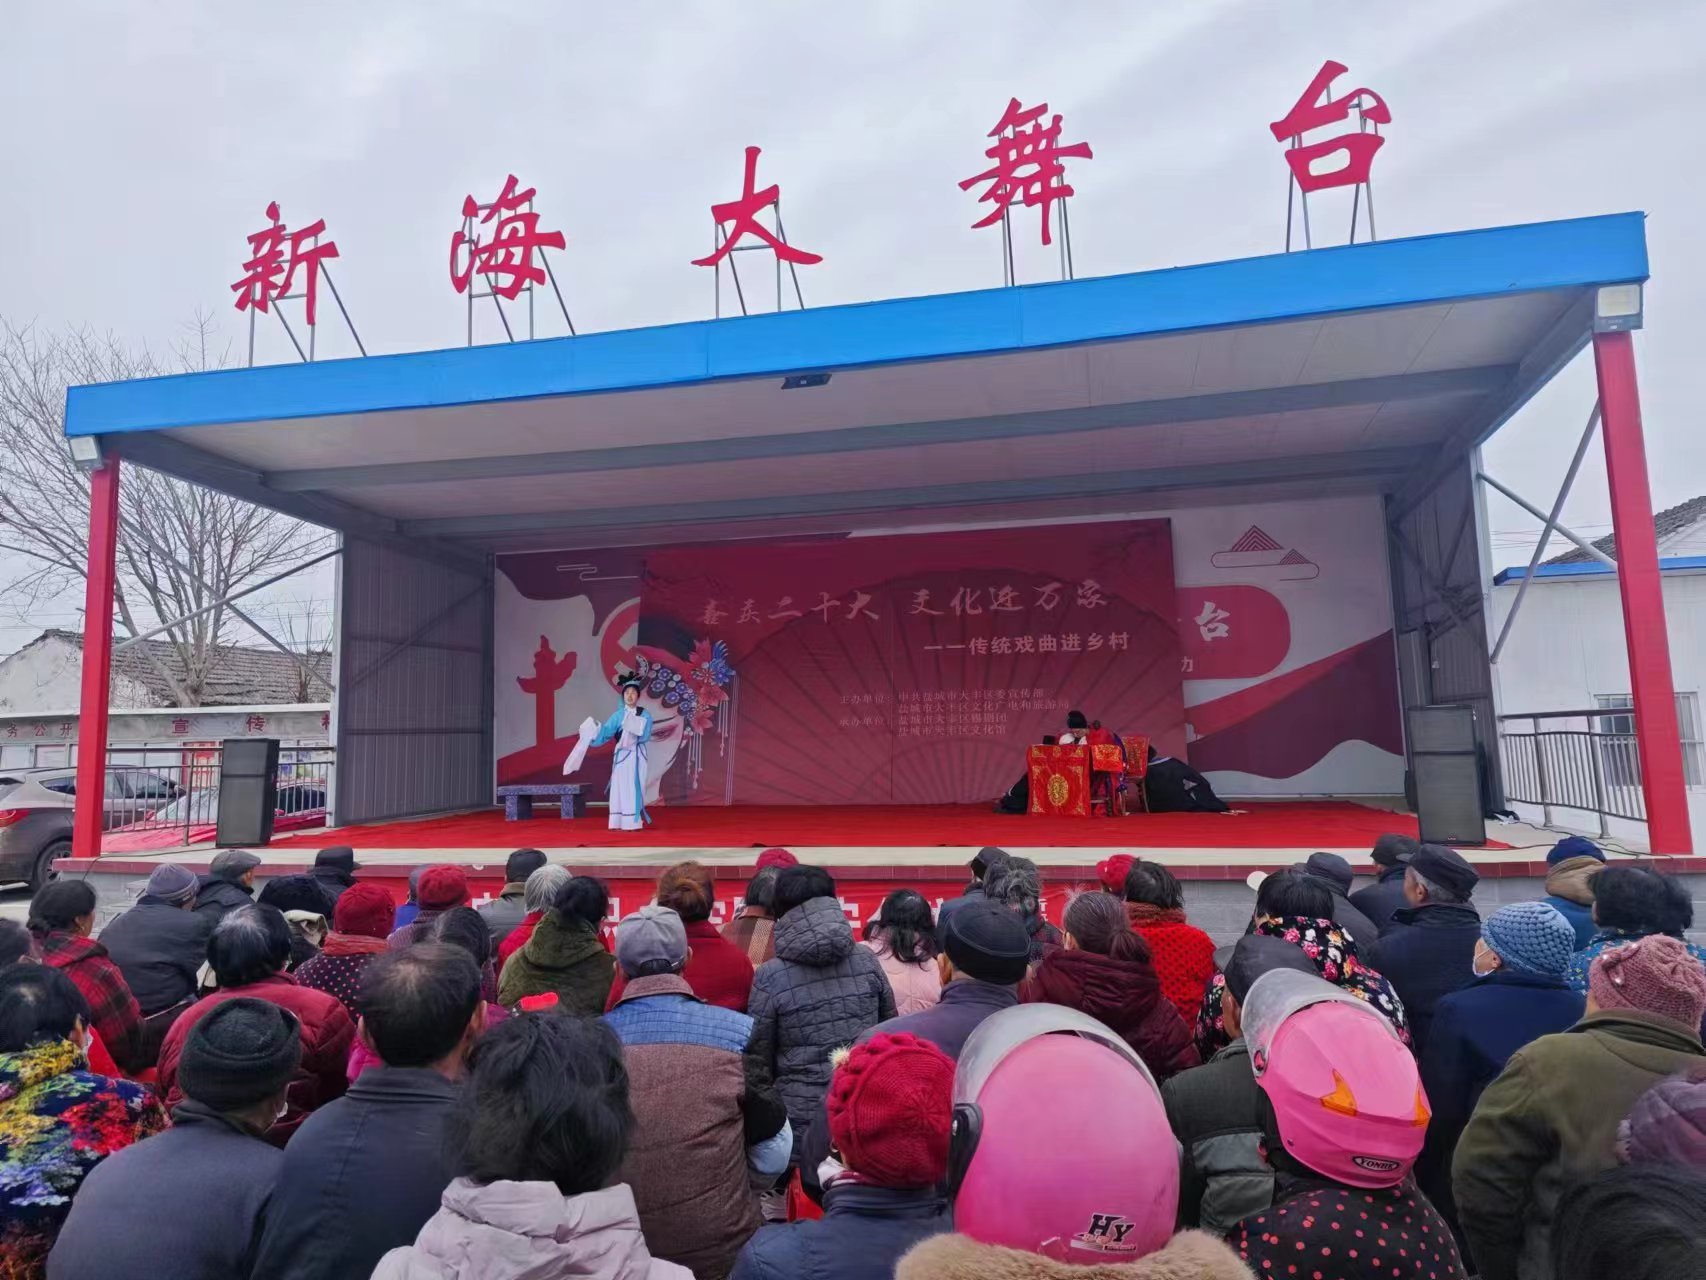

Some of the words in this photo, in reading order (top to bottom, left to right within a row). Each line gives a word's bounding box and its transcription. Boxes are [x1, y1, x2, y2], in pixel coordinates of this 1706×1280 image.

[231, 60, 1391, 325] 新海大舞台
[1194, 600, 1230, 641] 台
[7, 722, 72, 738] 务公开
[1087, 1213, 1136, 1243] HY
